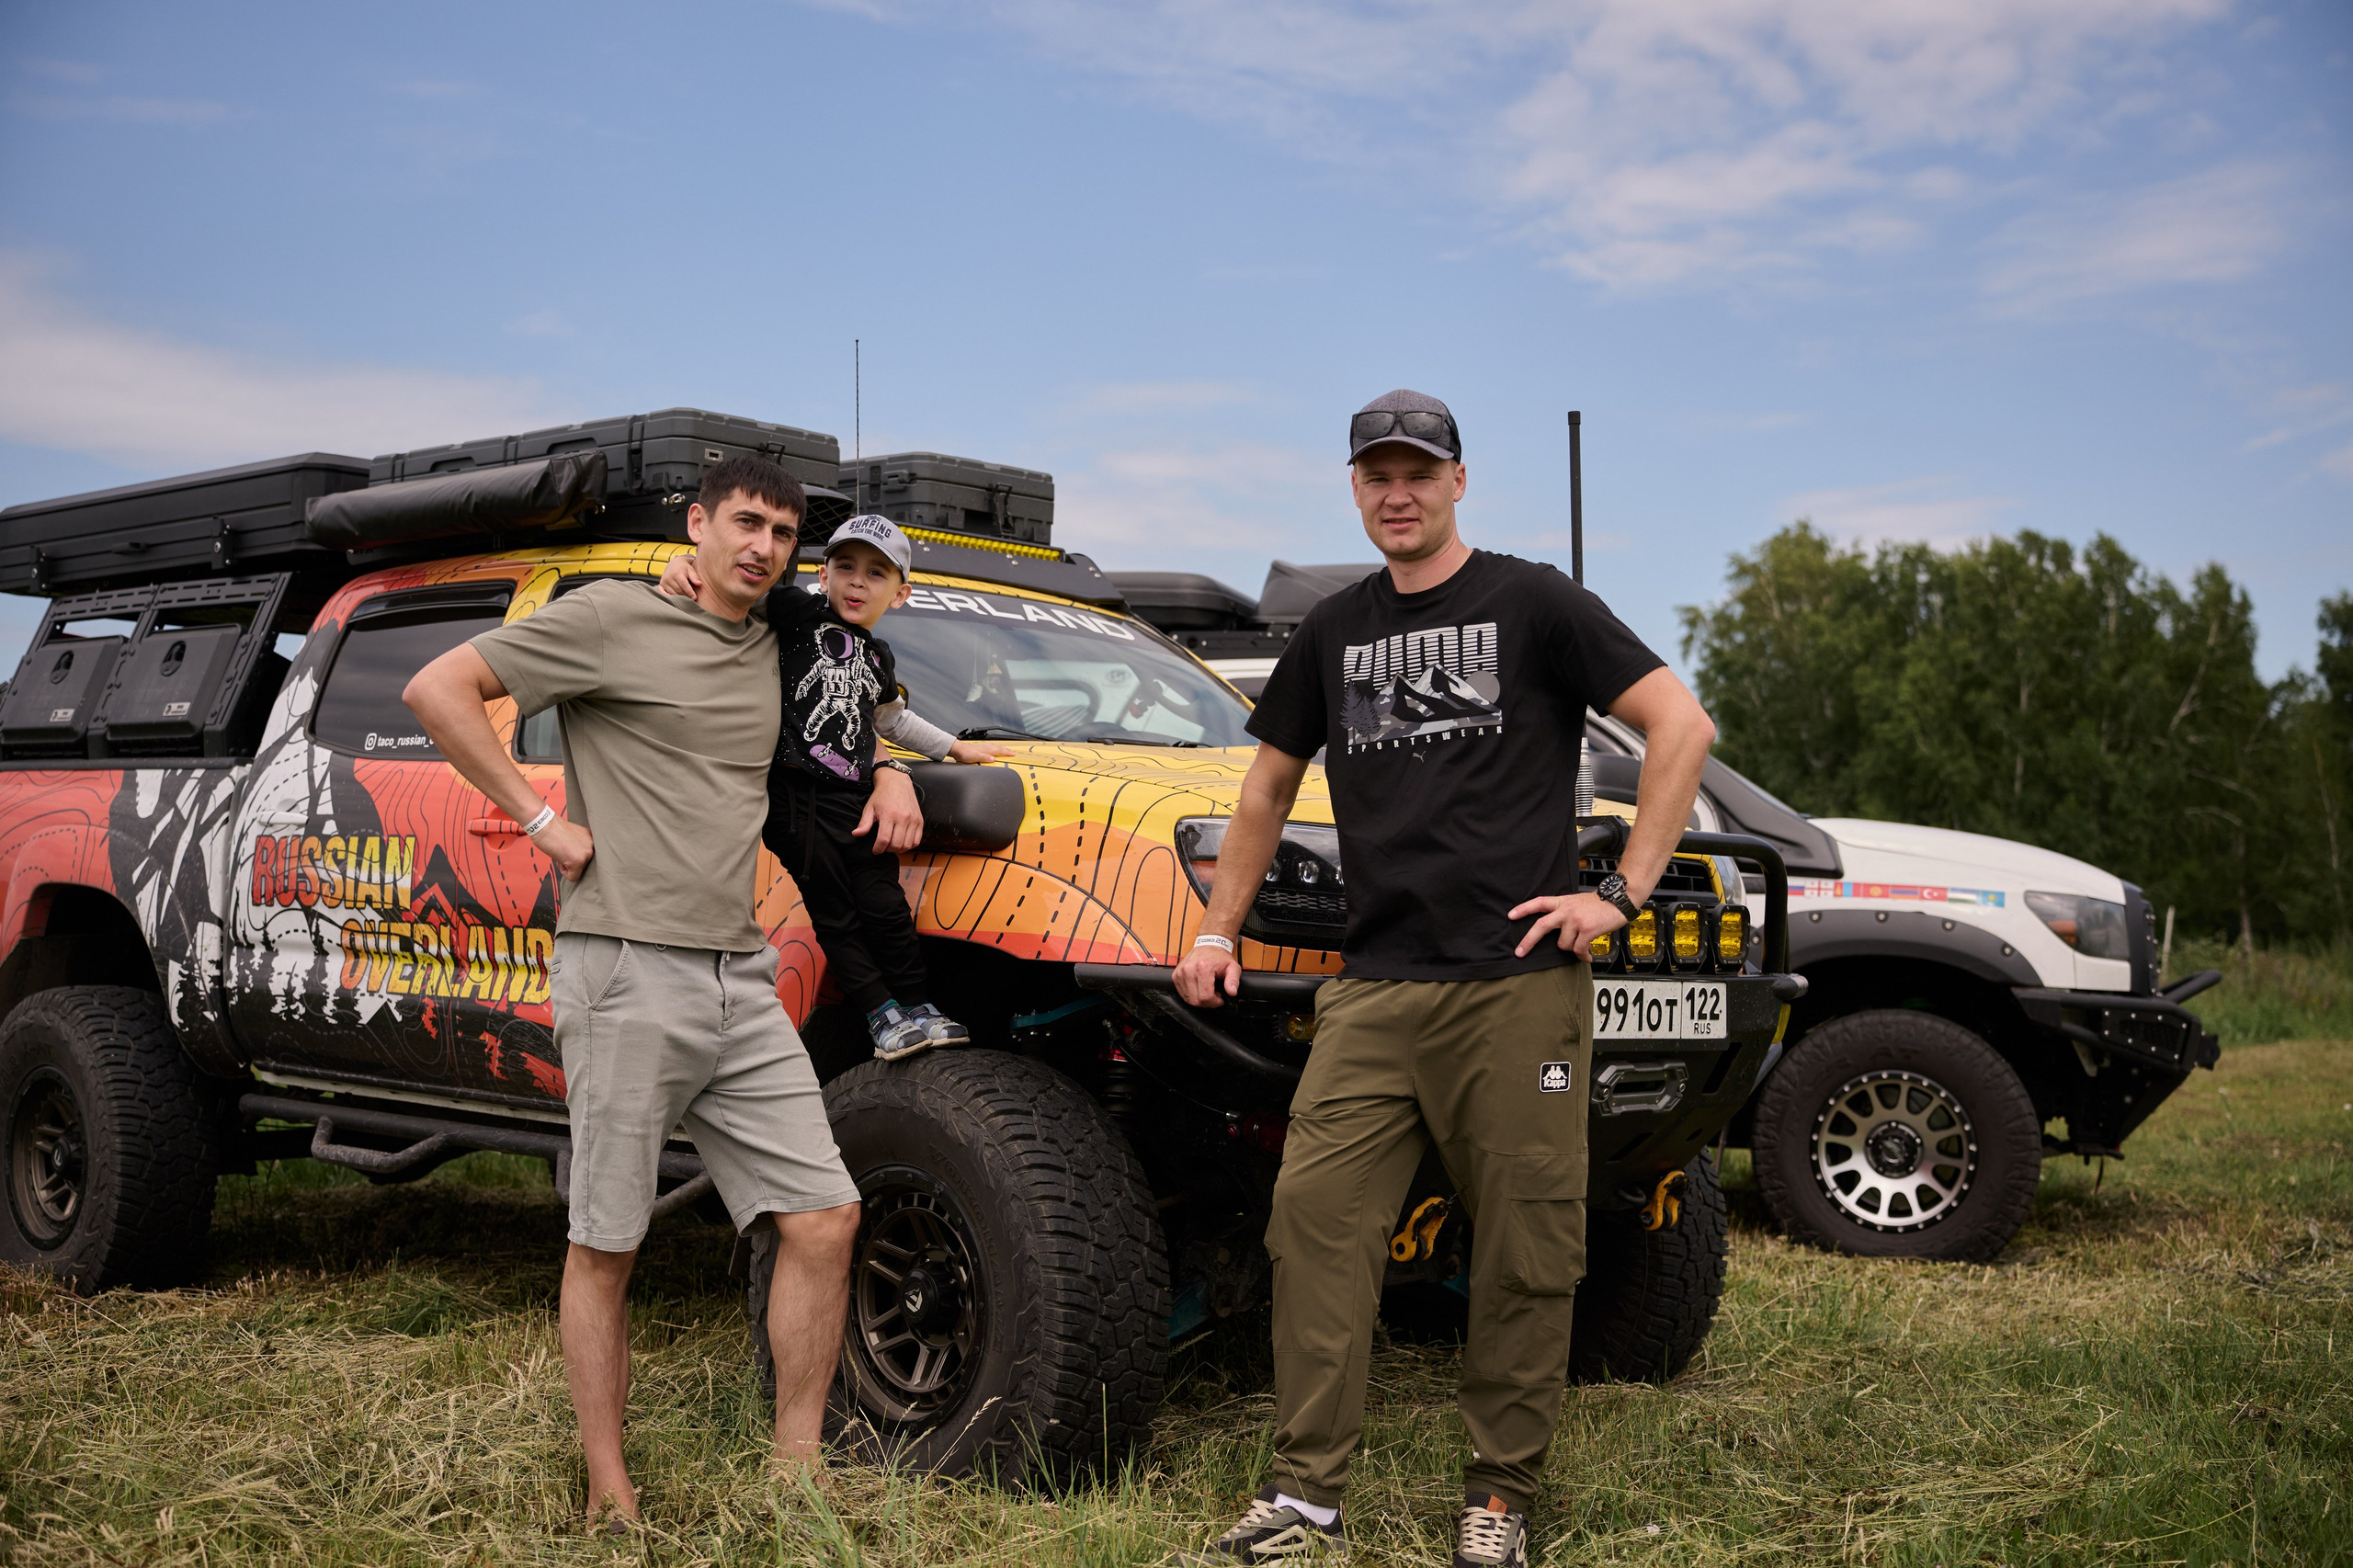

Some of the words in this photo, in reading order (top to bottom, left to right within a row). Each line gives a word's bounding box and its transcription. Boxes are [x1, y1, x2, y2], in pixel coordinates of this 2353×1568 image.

[848, 519, 892, 539] SURFING
[873, 531, 884, 541] WAVE
[1343, 621, 1498, 691] PUMA
[1347, 725, 1503, 755] SPORTSWEAR
[251, 835, 416, 910] RUSSIAN
[340, 918, 552, 1005] OVERLAND
[1686, 987, 1720, 1020] 122
[1693, 1022, 1711, 1034] RUS
[1543, 1079, 1566, 1088] Kappa
